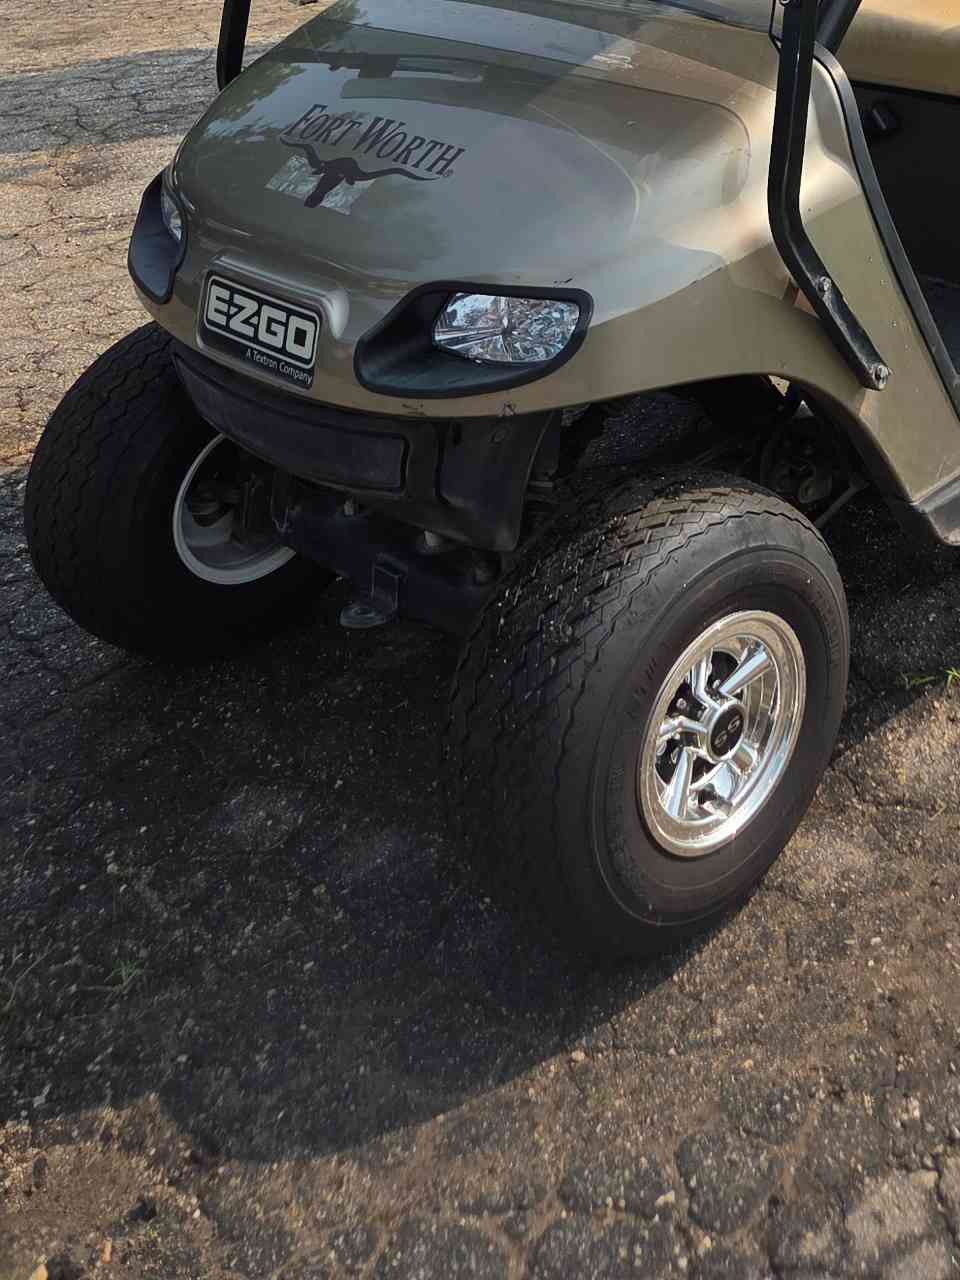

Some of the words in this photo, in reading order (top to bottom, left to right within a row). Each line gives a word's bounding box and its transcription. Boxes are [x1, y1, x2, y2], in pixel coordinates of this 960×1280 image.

[283, 104, 362, 147] FORT
[207, 283, 316, 360] EZGO
[245, 348, 252, 359] A
[252, 350, 278, 369] Textron
[279, 360, 313, 385] Company
